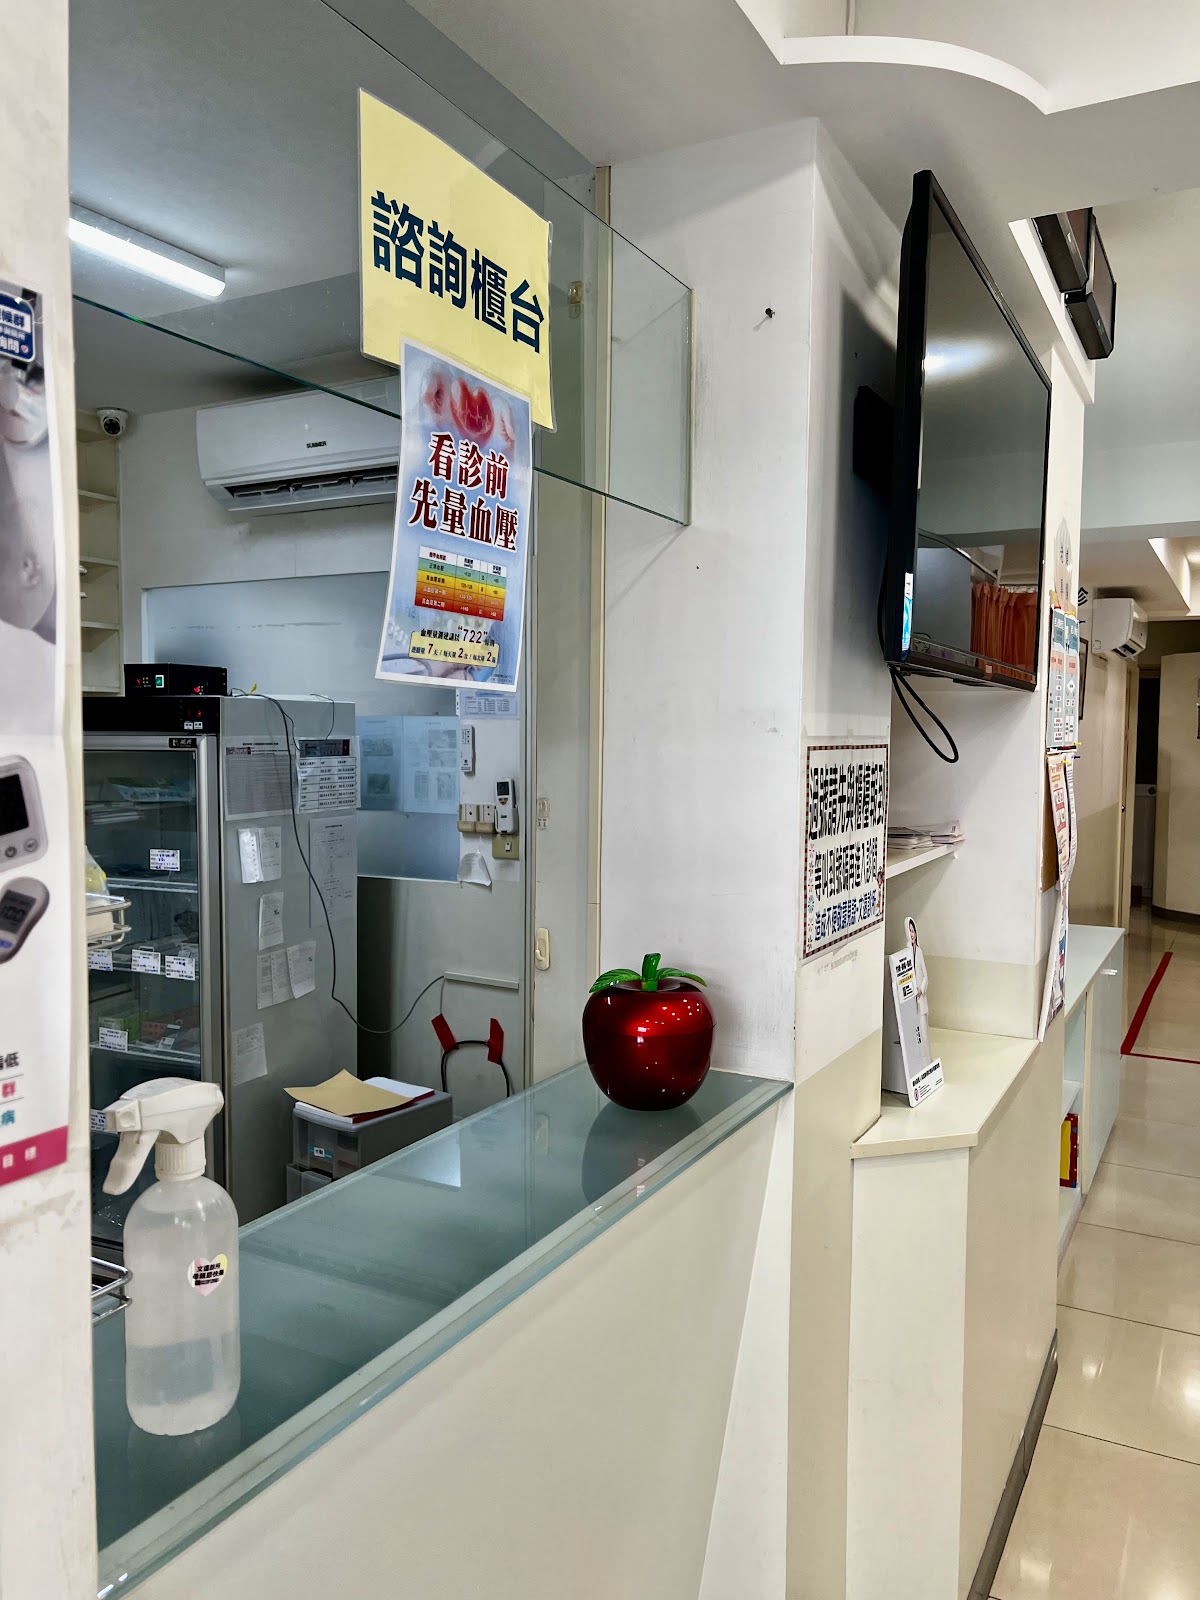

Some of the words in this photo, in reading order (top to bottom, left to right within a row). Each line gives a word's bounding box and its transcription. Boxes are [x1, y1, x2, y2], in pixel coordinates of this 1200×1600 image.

[371, 190, 545, 354] 諮詢櫃台
[429, 432, 509, 499] 看診前
[409, 479, 518, 551] 先量血壓
